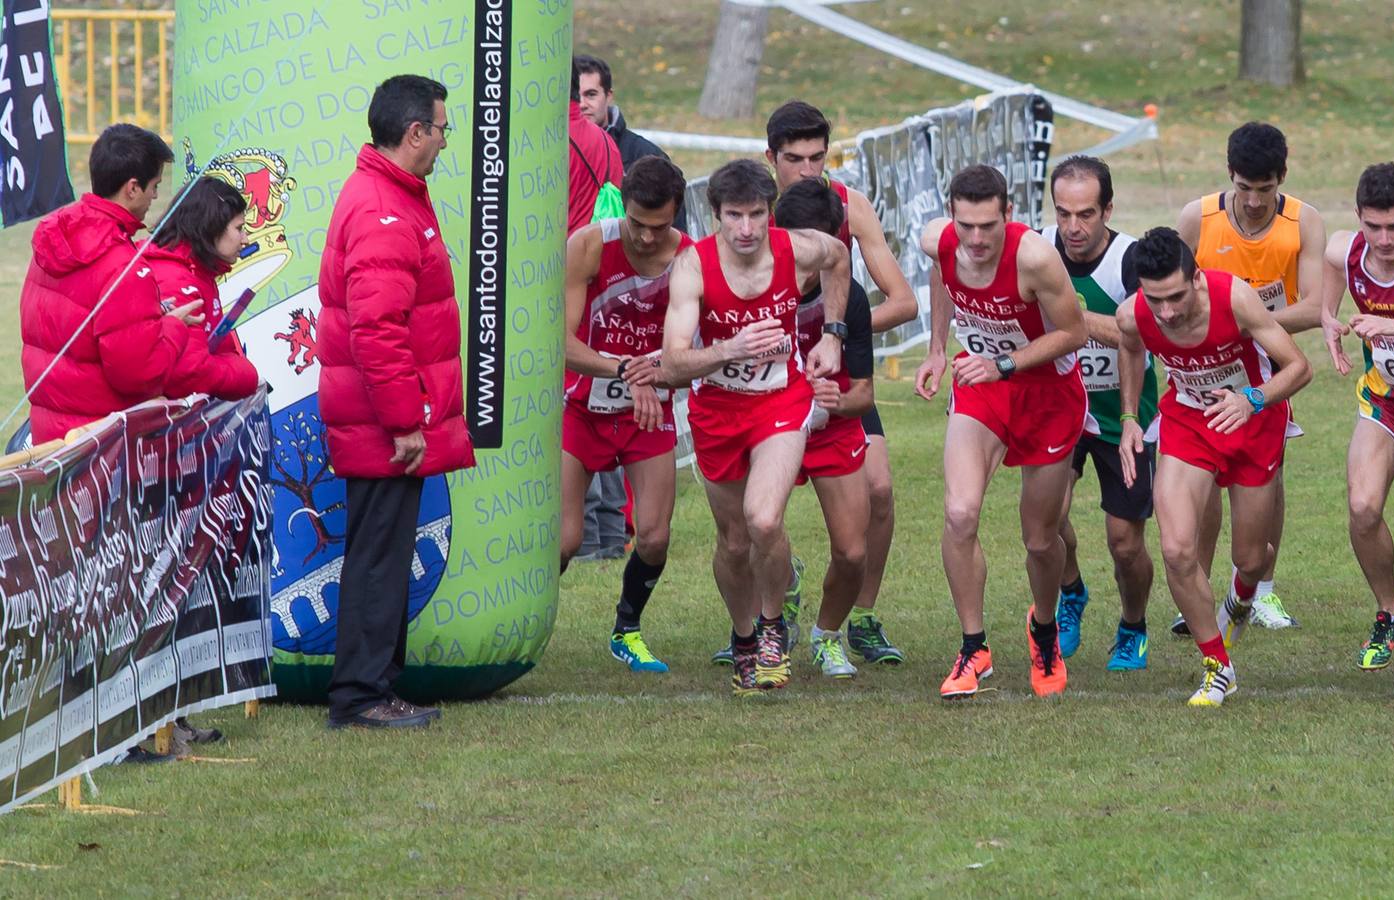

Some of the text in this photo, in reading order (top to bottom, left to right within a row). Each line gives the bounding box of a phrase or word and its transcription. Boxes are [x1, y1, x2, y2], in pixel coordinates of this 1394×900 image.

[204, 8, 330, 63] CALZADA
[275, 52, 317, 86] DE
[326, 42, 366, 73] LA
[213, 100, 305, 149] SANTO
[705, 297, 797, 324] AÑARES
[968, 334, 1017, 355] 659
[723, 360, 776, 383] 657
